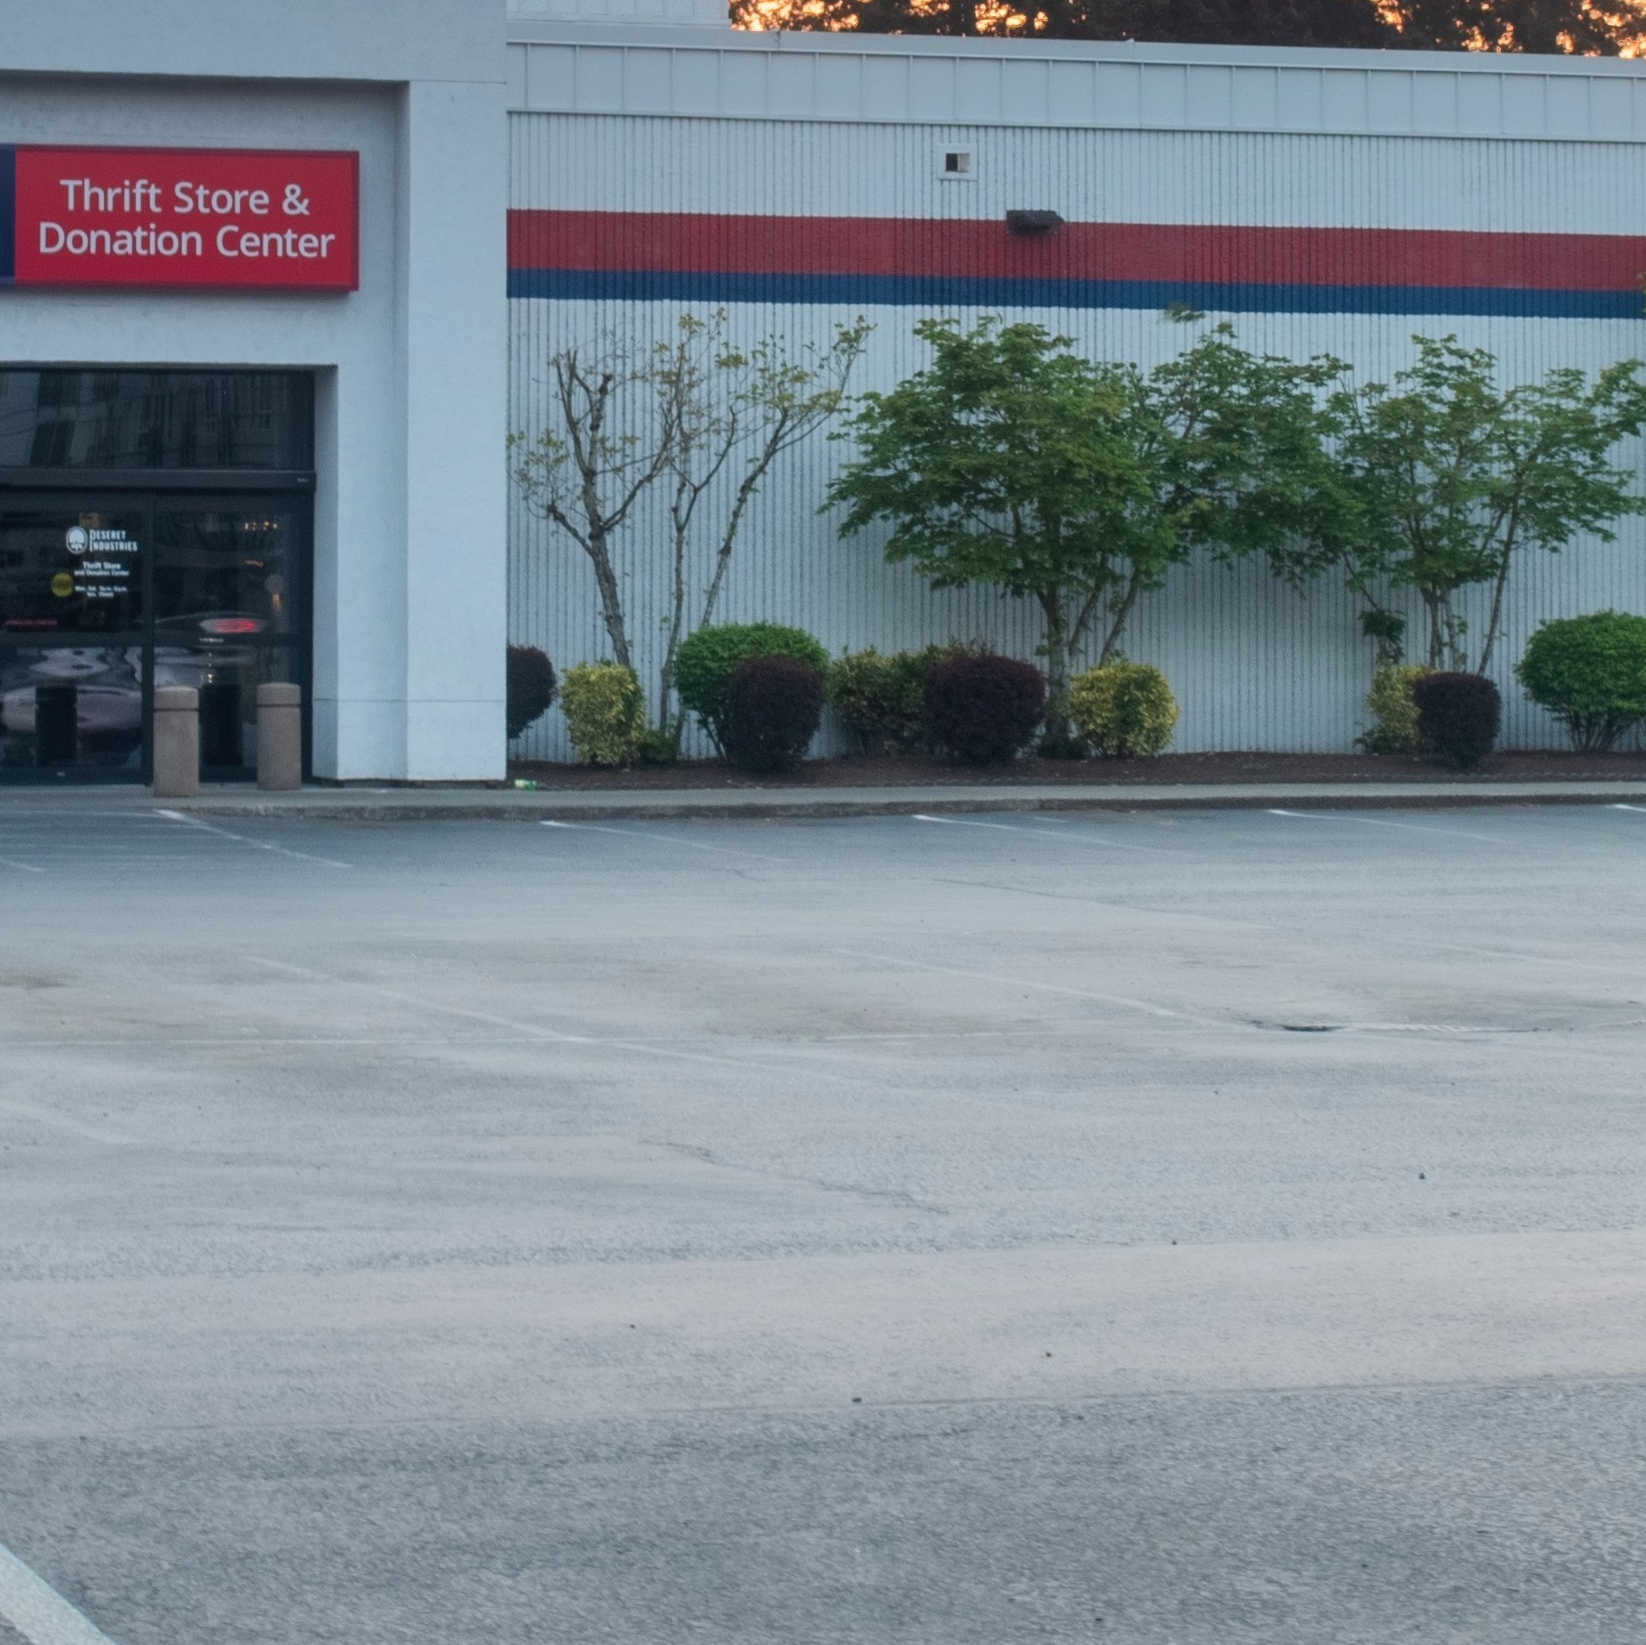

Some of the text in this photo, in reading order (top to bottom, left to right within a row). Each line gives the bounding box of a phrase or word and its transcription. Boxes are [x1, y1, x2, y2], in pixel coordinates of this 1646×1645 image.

[59, 178, 310, 216] Thrift Store &
[39, 221, 336, 258] Donation Center
[89, 529, 126, 540] DESERET
[89, 540, 138, 552] INDUSTRIES
